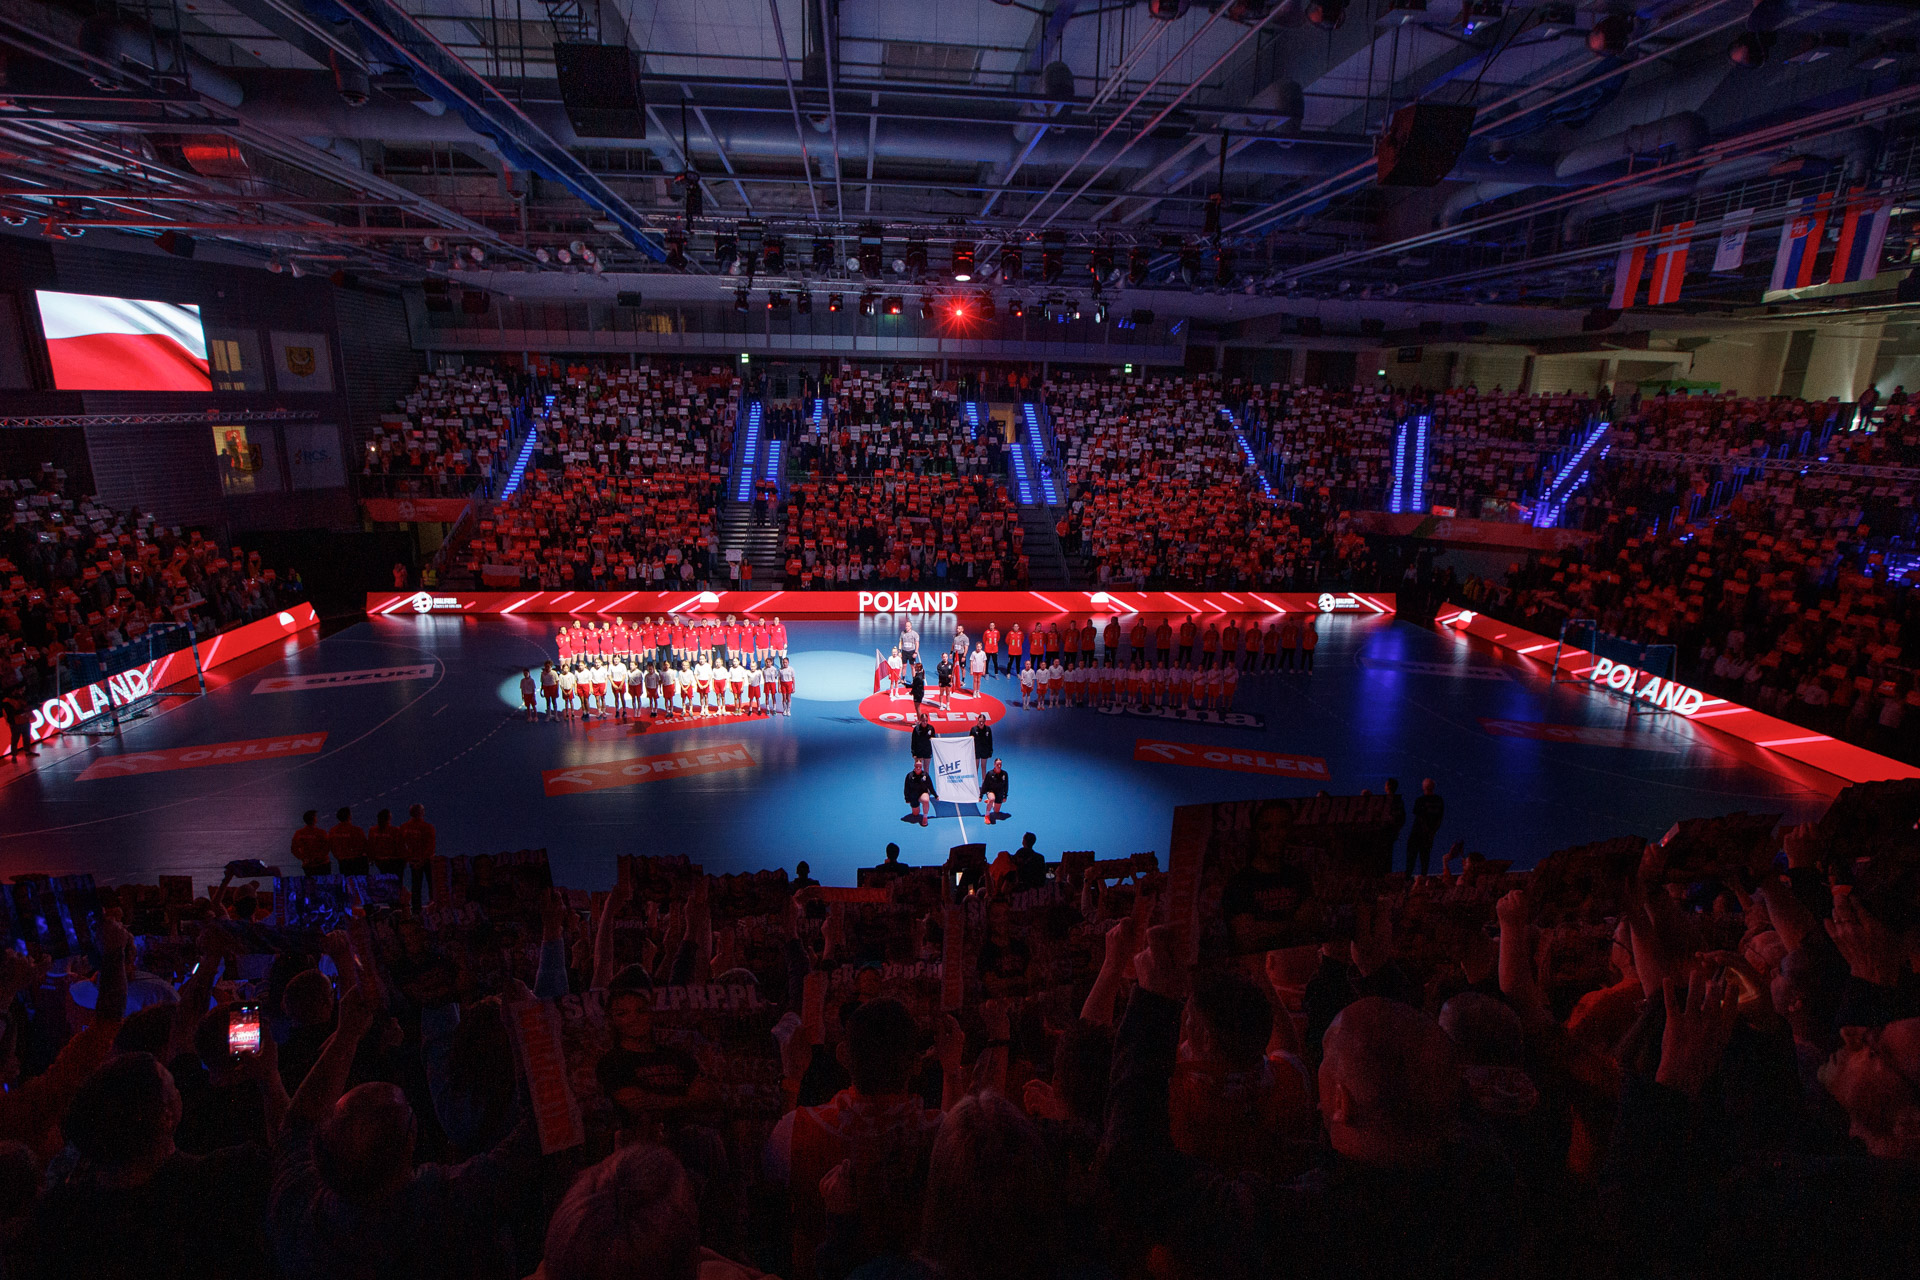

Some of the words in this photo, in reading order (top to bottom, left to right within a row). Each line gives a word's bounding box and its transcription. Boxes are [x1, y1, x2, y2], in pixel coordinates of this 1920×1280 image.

[859, 591, 958, 612] POLAND
[306, 668, 428, 684] SUZUKI
[1590, 657, 1704, 715] POLAND
[30, 668, 150, 740] POLAND
[178, 737, 323, 762] ORLEN
[621, 750, 747, 777] ORLEN
[938, 760, 962, 774] EHF
[1203, 751, 1326, 774] ORLEN
